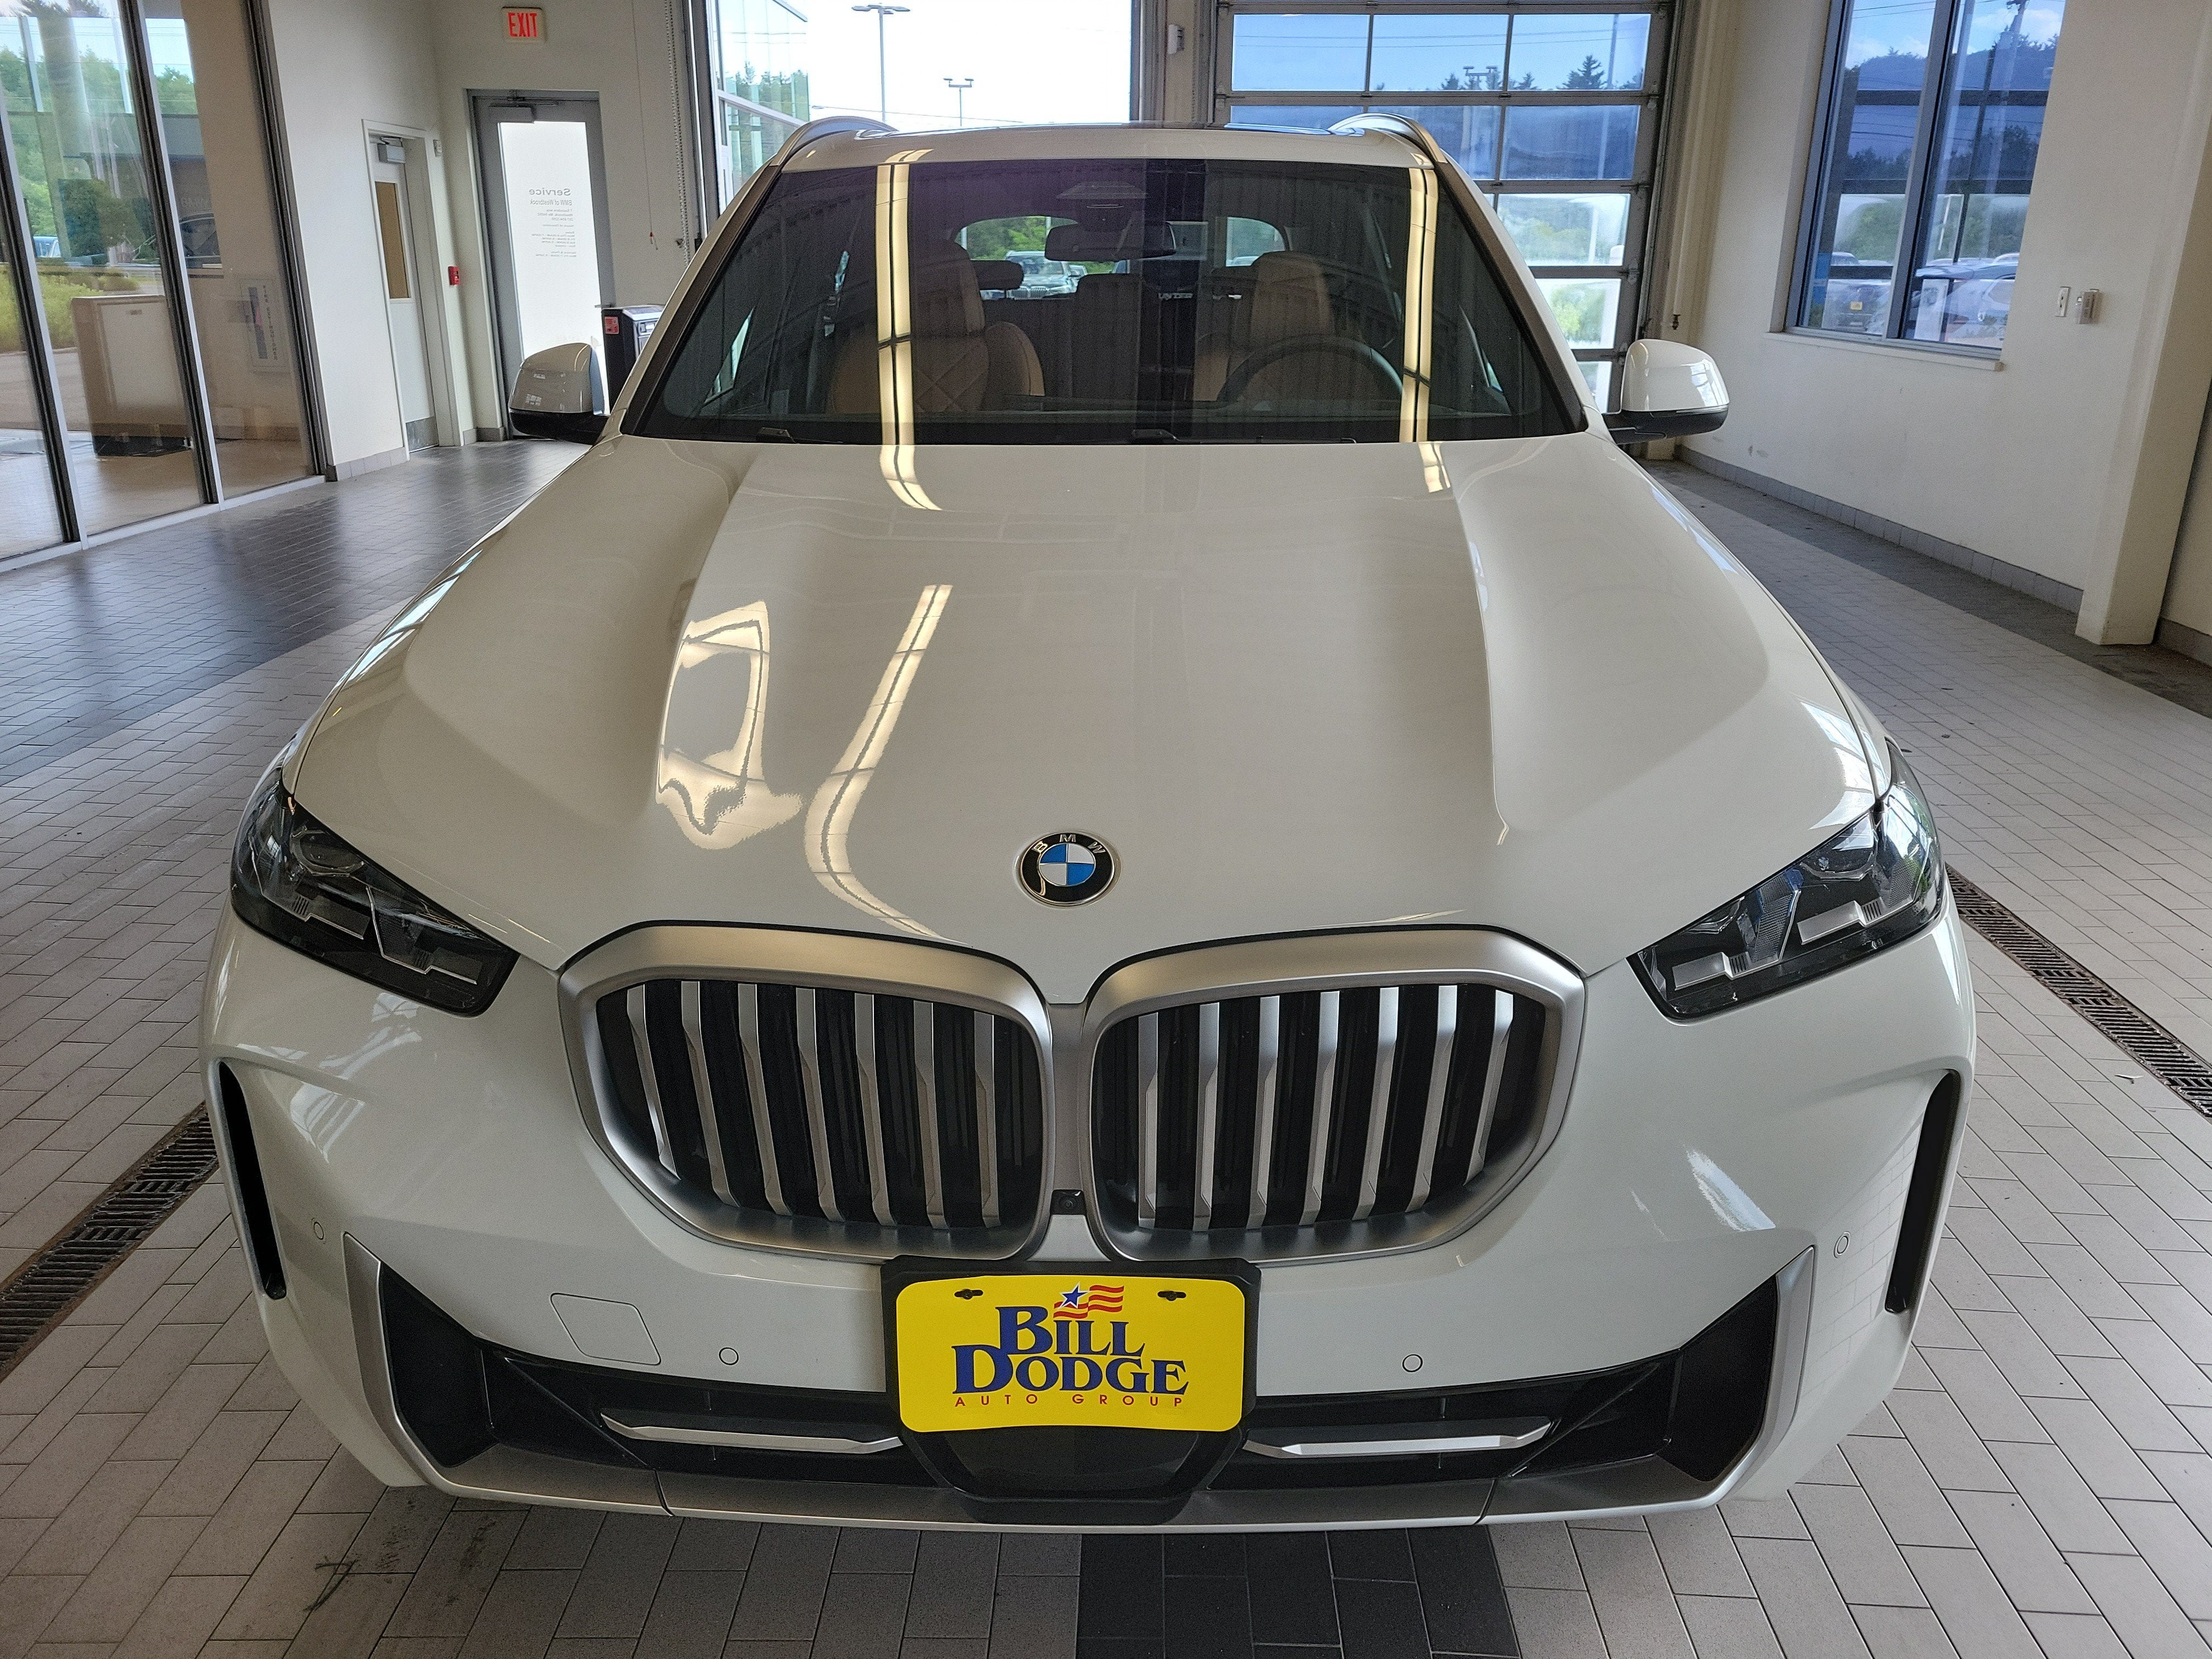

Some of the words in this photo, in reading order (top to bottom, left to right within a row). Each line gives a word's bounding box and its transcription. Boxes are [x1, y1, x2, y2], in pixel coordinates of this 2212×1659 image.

[507, 12, 537, 37] EXIT
[1030, 834, 1106, 854] BMW
[995, 1306, 1146, 1357] BILL
[951, 1344, 1189, 1395] DODGE
[955, 1393, 1038, 1407] AUTO
[1072, 1393, 1182, 1407] GROUP
